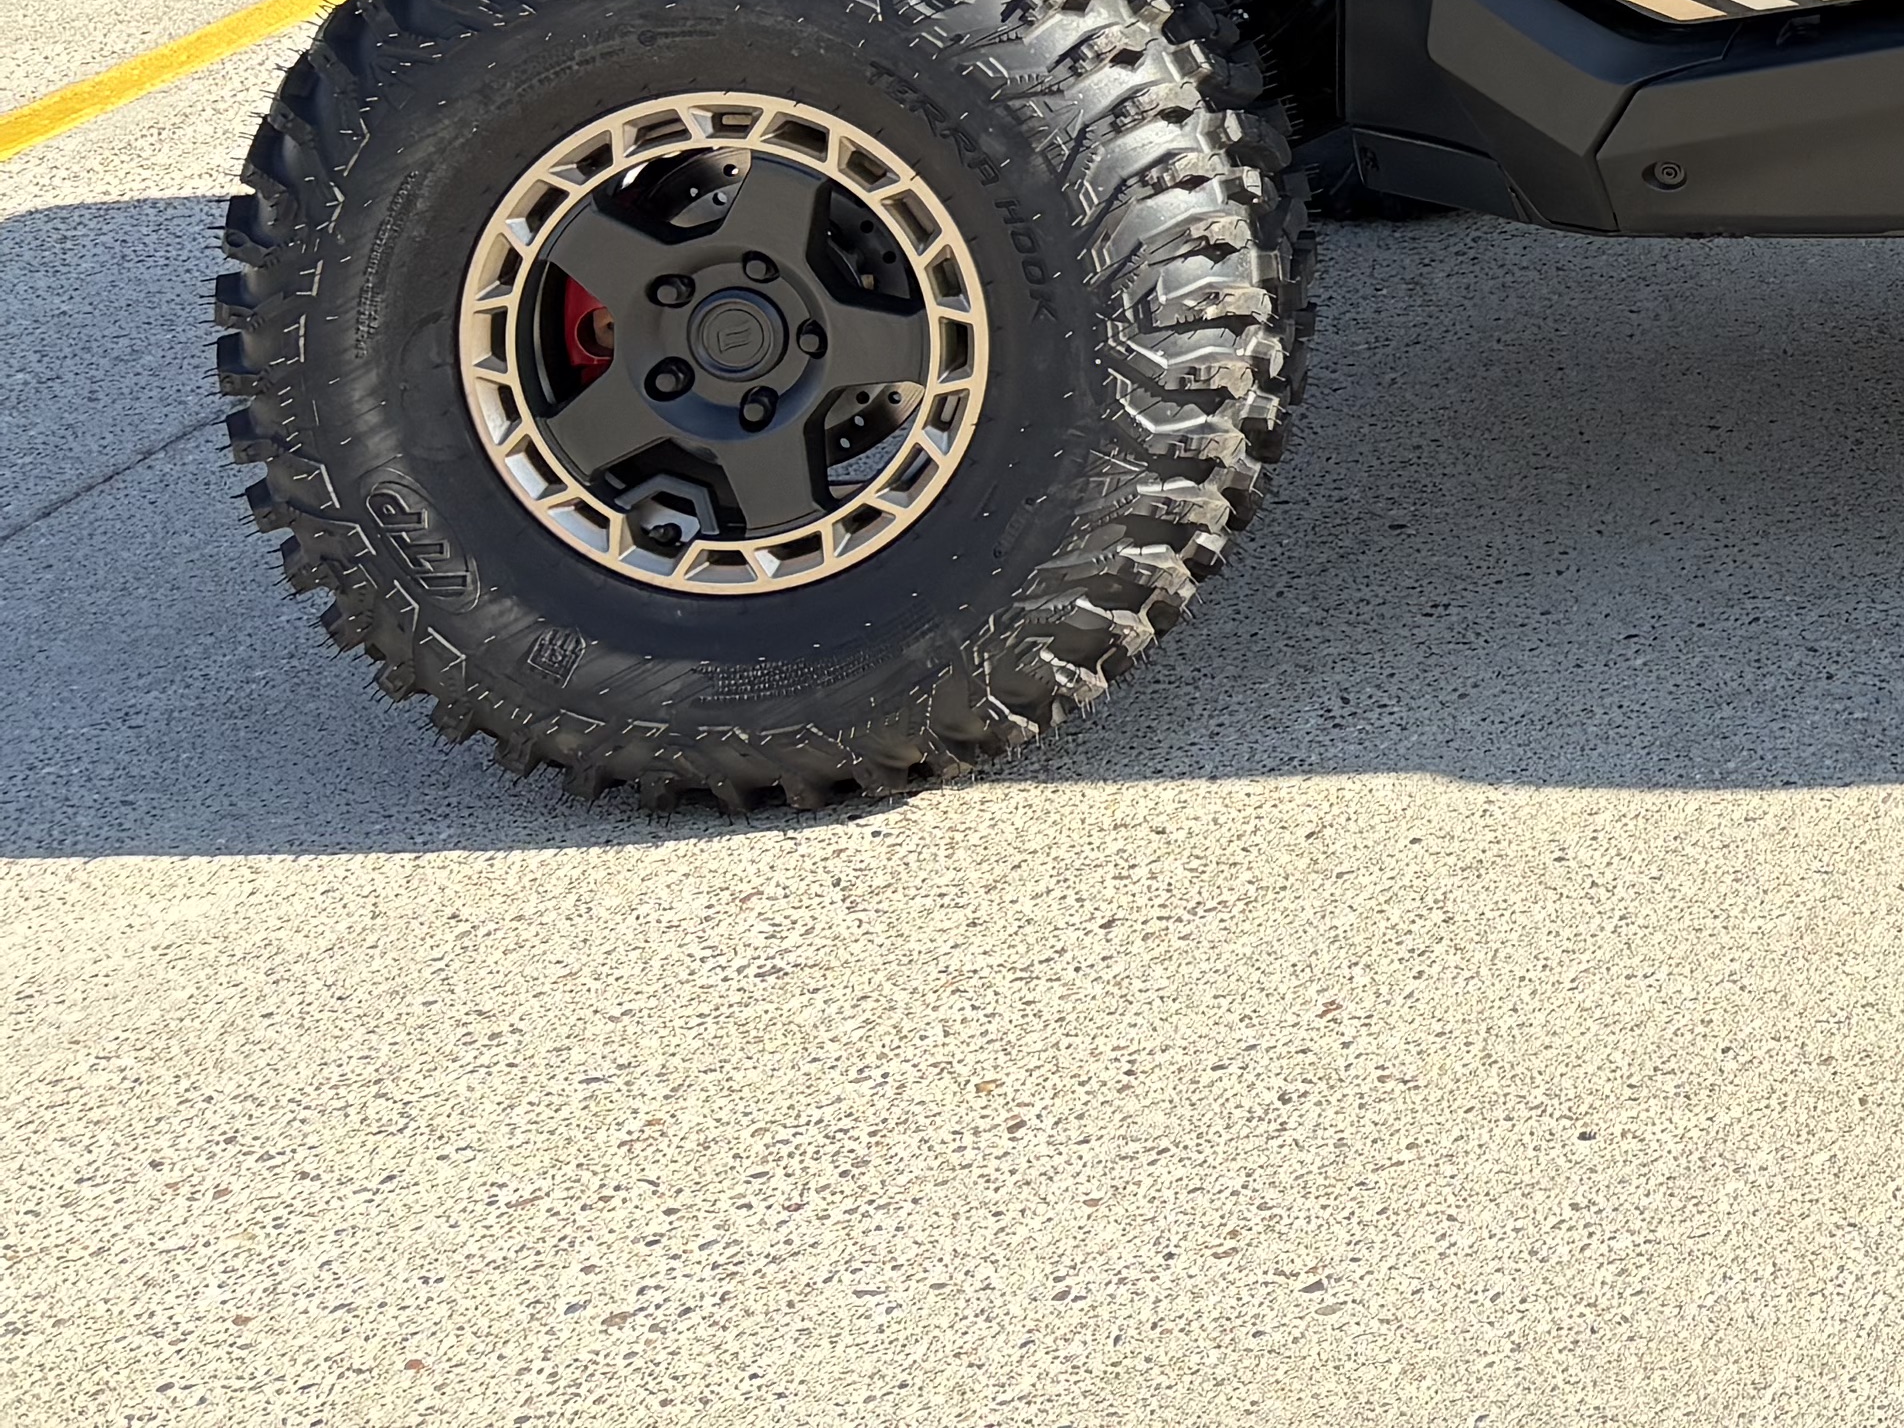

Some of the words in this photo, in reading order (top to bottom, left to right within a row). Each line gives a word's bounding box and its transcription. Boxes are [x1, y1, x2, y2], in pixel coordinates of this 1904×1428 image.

[867, 59, 1001, 187] TERRA
[993, 197, 1059, 325] HOOK
[367, 488, 470, 592] ITP
